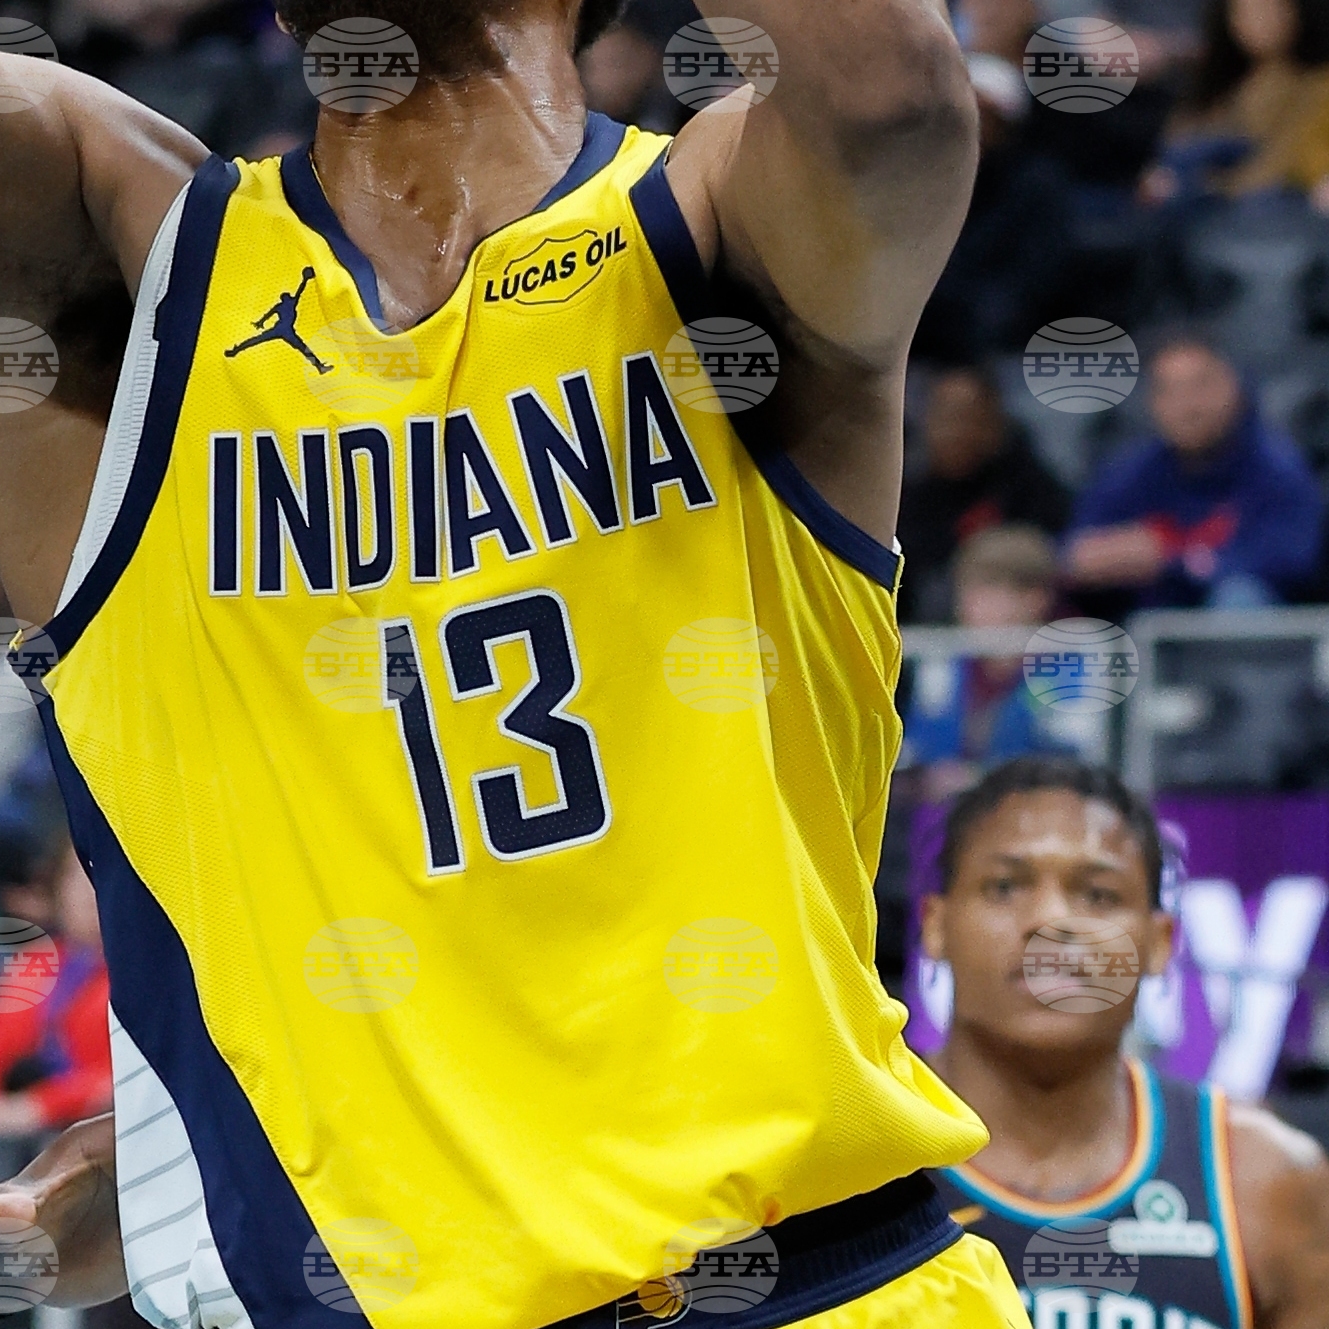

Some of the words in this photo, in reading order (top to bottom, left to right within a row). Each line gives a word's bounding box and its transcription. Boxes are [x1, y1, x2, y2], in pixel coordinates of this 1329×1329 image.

[484, 251, 577, 302] LUCAS
[586, 226, 627, 267] OIL
[207, 349, 718, 598] INDIANA
[378, 586, 614, 877] 13
